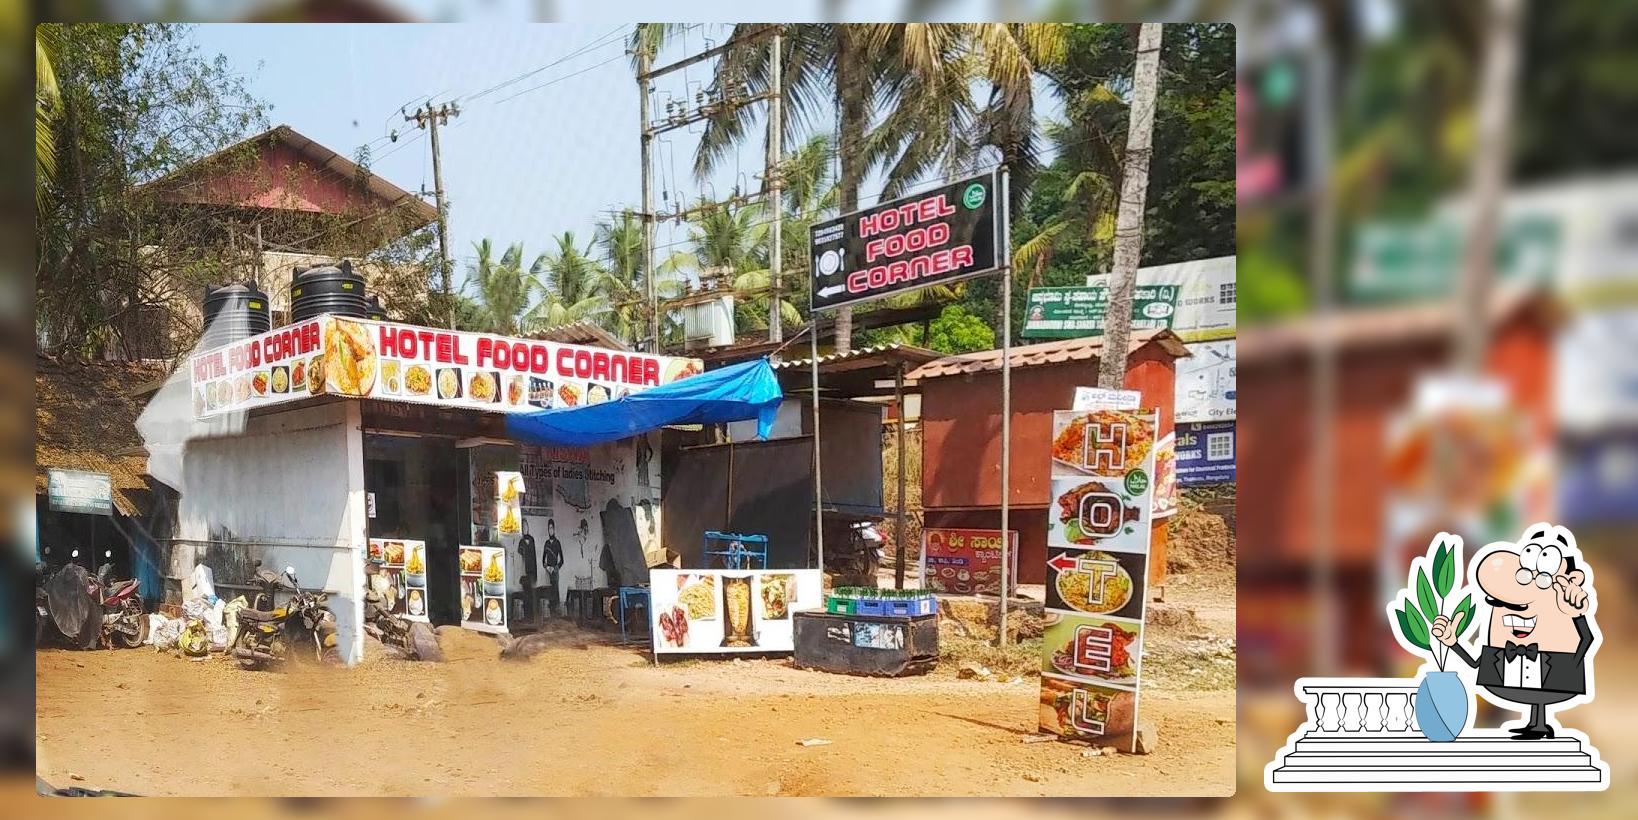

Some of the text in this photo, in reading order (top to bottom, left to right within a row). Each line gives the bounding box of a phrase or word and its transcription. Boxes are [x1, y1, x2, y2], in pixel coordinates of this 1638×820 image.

[859, 194, 956, 238] HOTEL
[866, 222, 949, 263] FOOD
[847, 244, 974, 294] CORNER
[193, 321, 321, 384] HOTEL FOOD CORNER
[379, 325, 661, 386] HOTEL FOOD CORNER
[1208, 408, 1224, 417] City
[520, 464, 530, 477] All
[530, 464, 552, 480] Types
[553, 466, 560, 477] of
[1070, 422, 1127, 736] HOTEL
